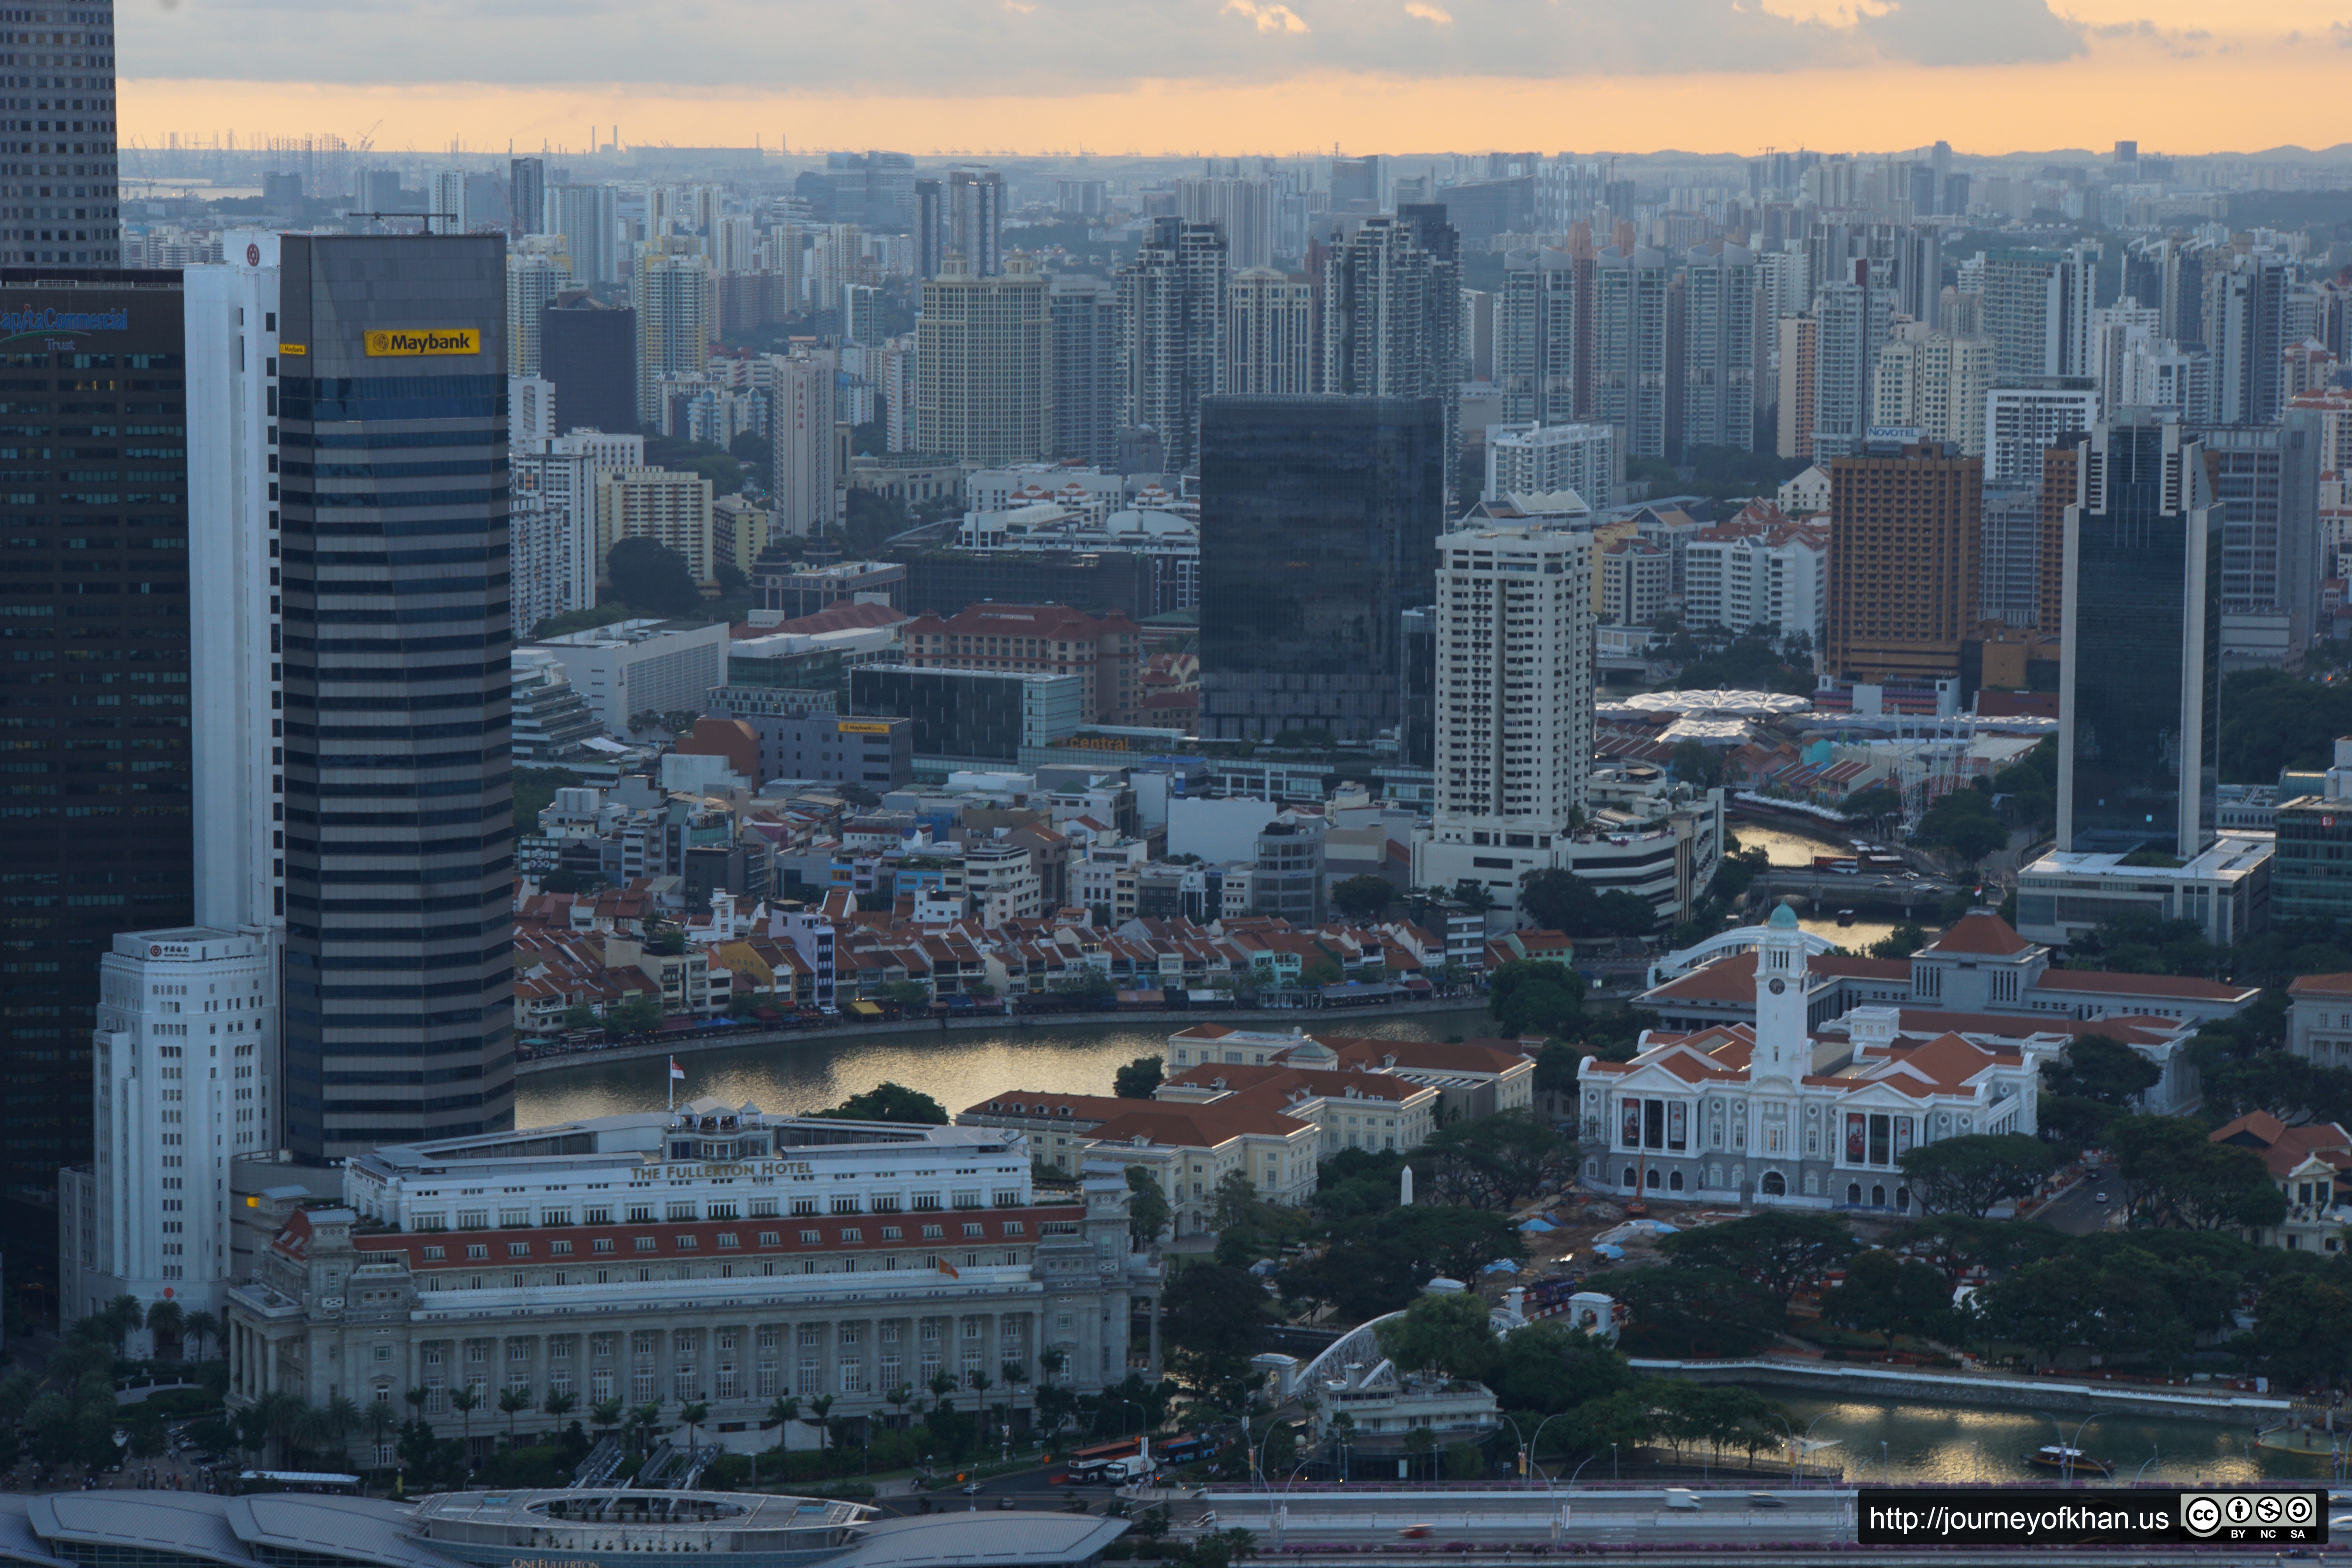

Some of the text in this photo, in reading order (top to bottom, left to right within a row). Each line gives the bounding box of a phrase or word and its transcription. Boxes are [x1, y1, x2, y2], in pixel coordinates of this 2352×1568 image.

[0, 304, 127, 336] apitaCommercial
[45, 338, 75, 351] Trust
[285, 345, 304, 353] Maybank
[391, 332, 471, 354] Maybank
[1868, 427, 1917, 438] NOVOTEL
[1069, 737, 1129, 751] central
[631, 1161, 812, 1180] THE FULLERTON HOTEL
[539, 1559, 600, 1568] FULLERTON
